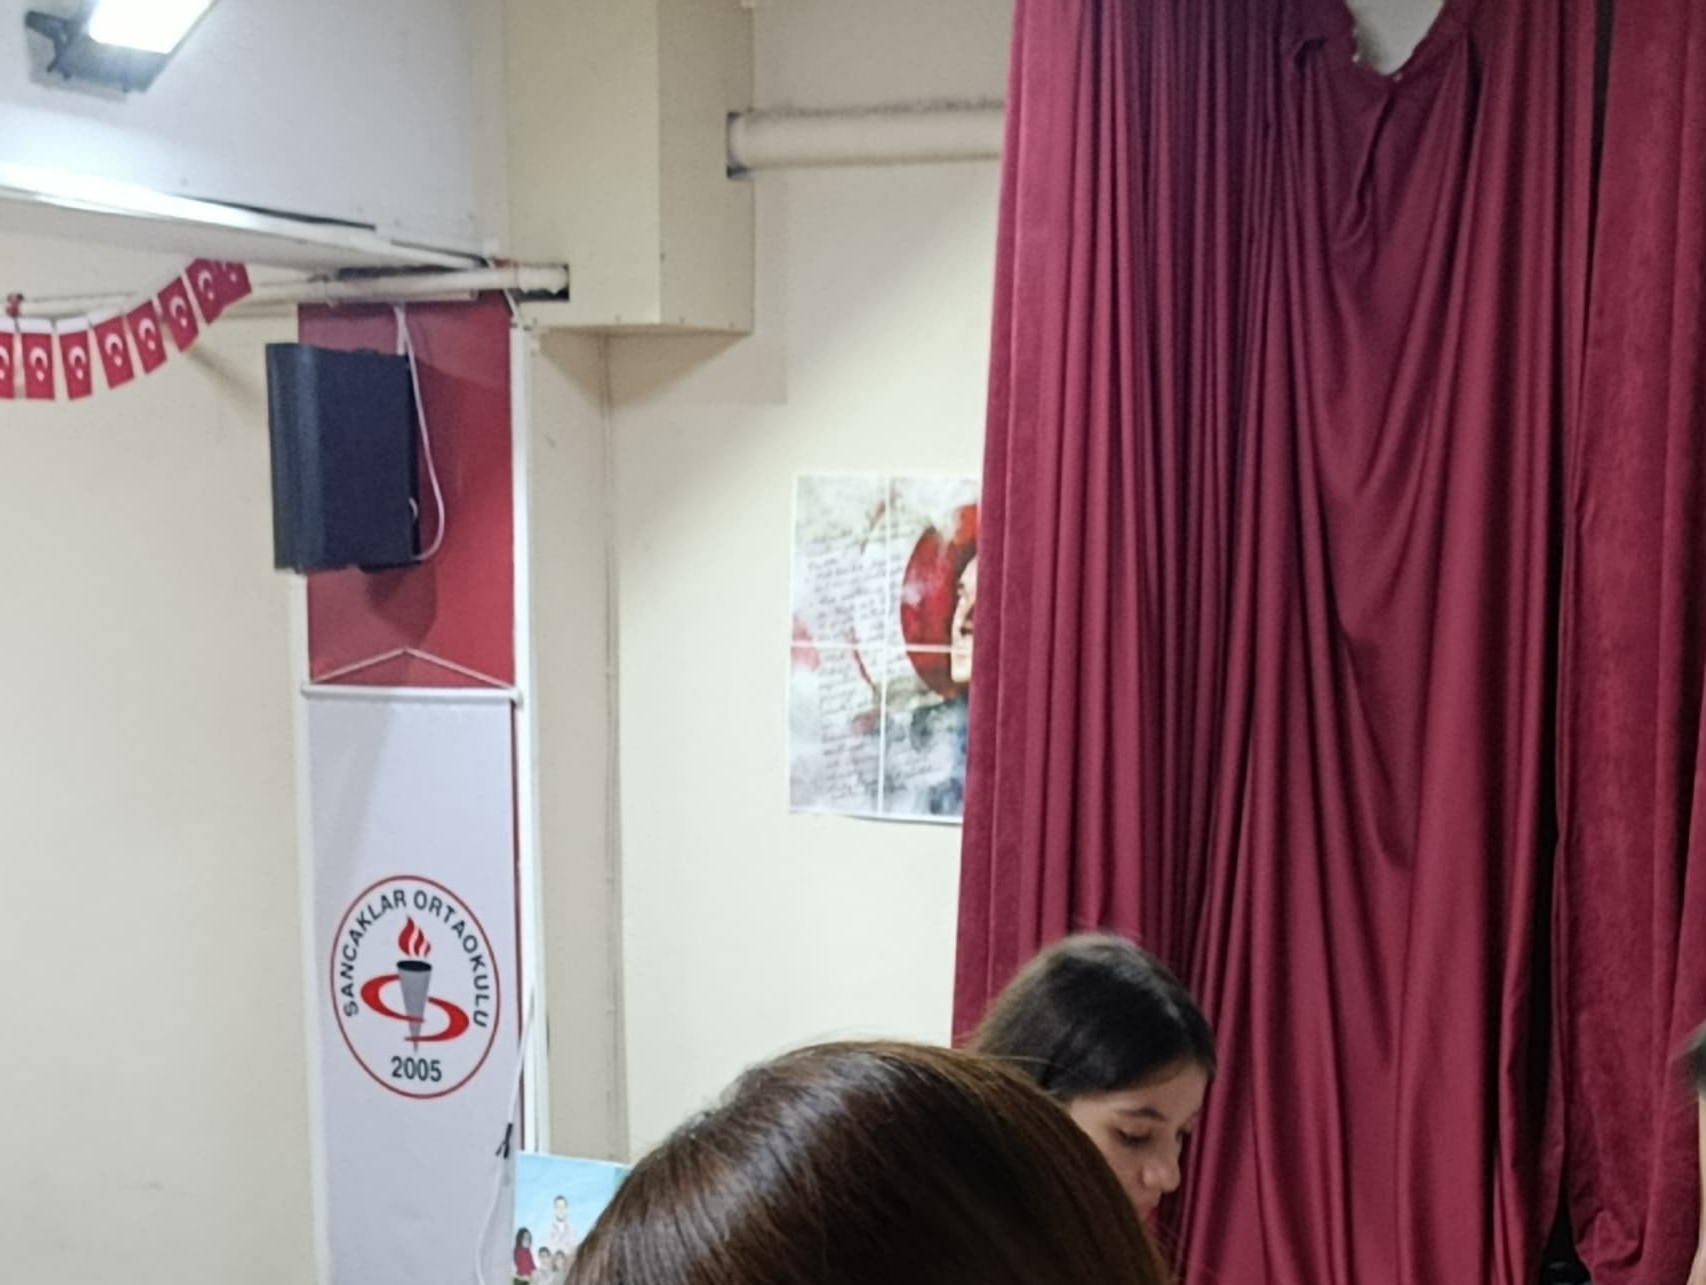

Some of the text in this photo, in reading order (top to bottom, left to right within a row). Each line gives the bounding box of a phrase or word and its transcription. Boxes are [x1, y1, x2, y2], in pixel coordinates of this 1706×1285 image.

[340, 889, 491, 1028] SANCAKLAR ORTAOKULU
[390, 1055, 443, 1083] 2005
